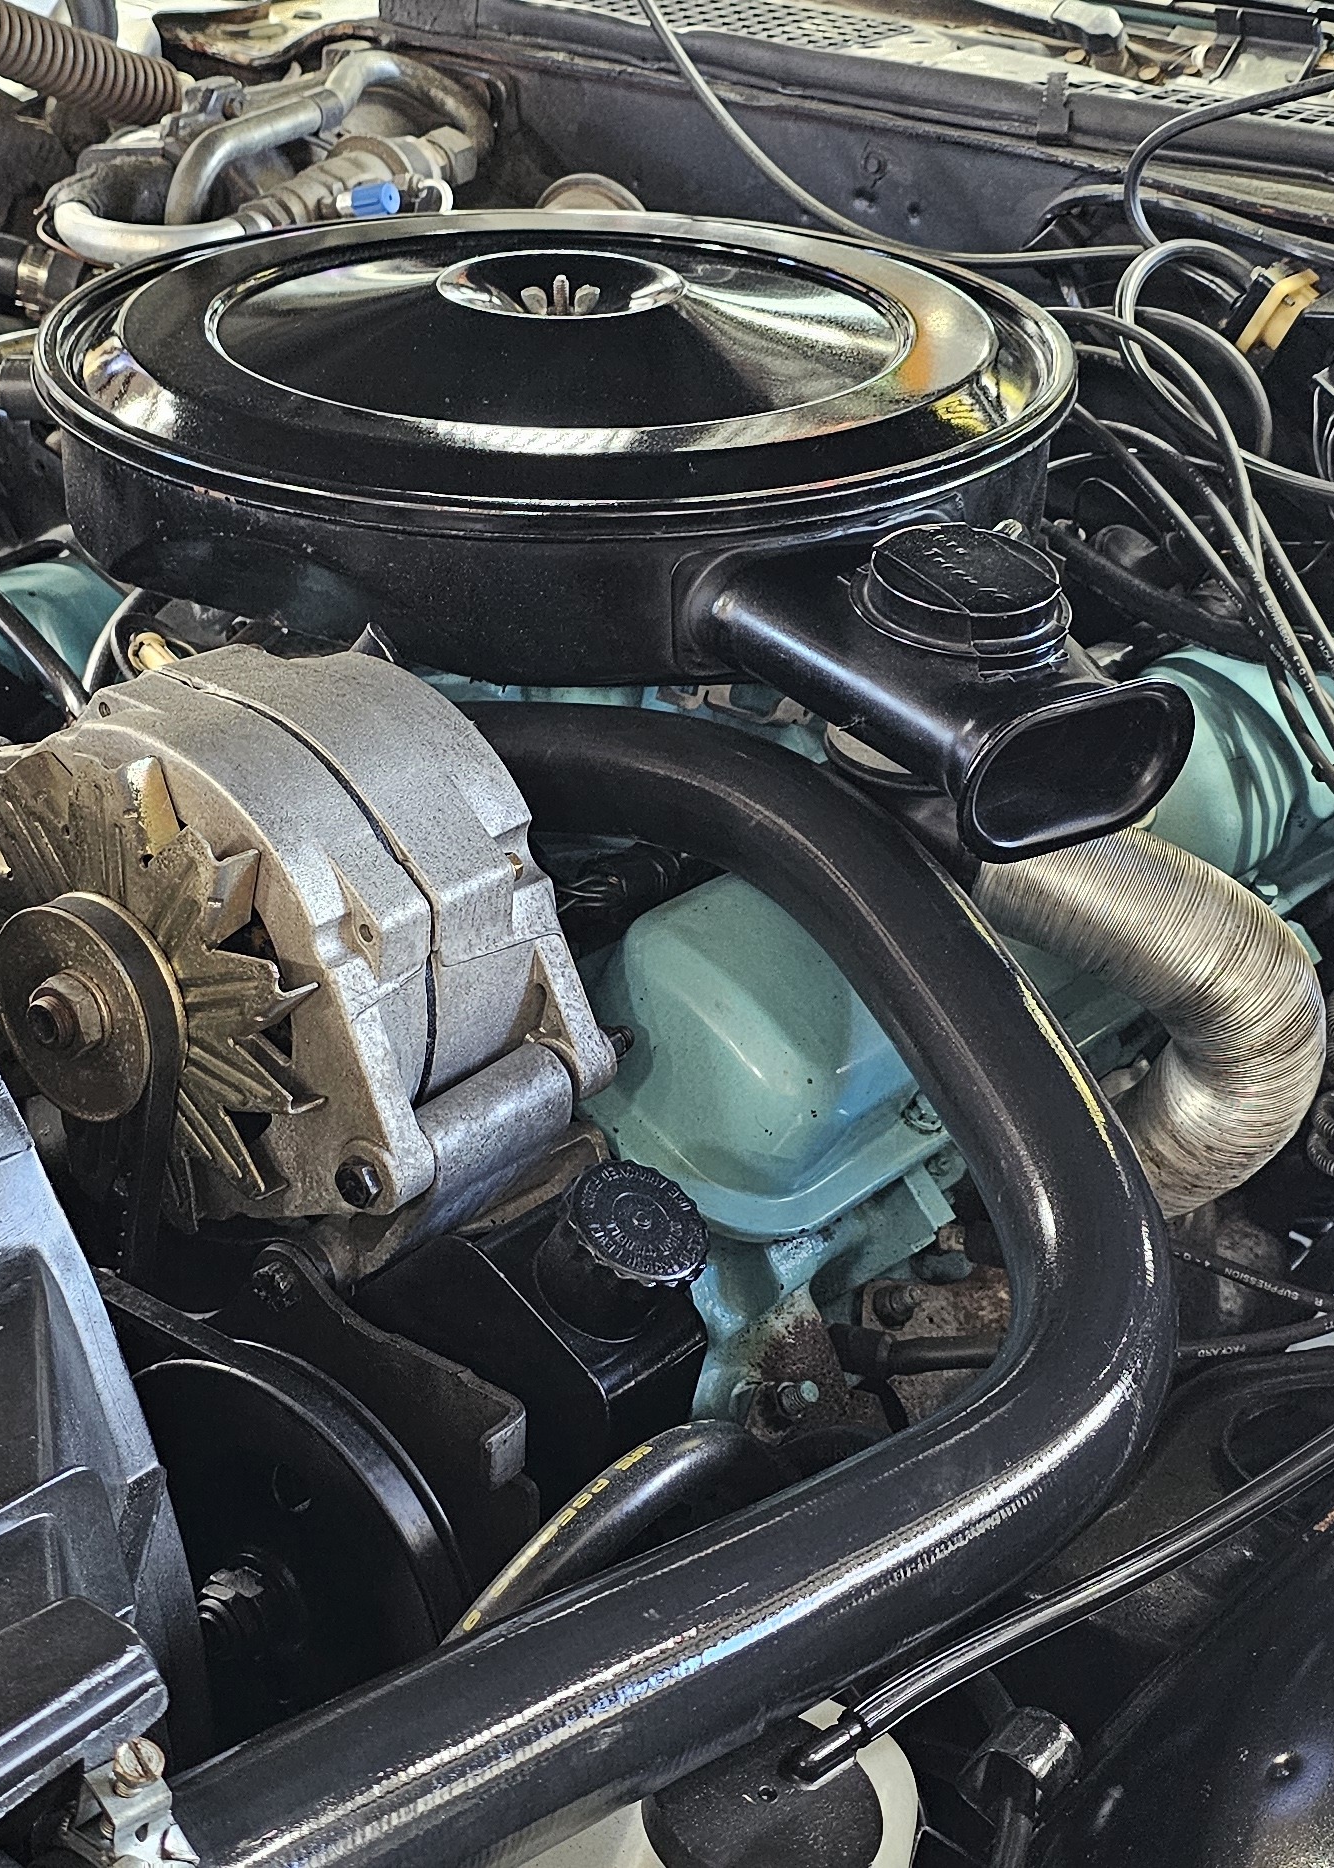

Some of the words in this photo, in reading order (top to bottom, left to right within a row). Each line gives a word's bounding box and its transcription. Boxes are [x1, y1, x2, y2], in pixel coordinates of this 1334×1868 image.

[1224, 1266, 1301, 1301] SUPPRESSION
[1314, 1297, 1324, 1307] R
[1197, 1343, 1247, 1359] PACKARD
